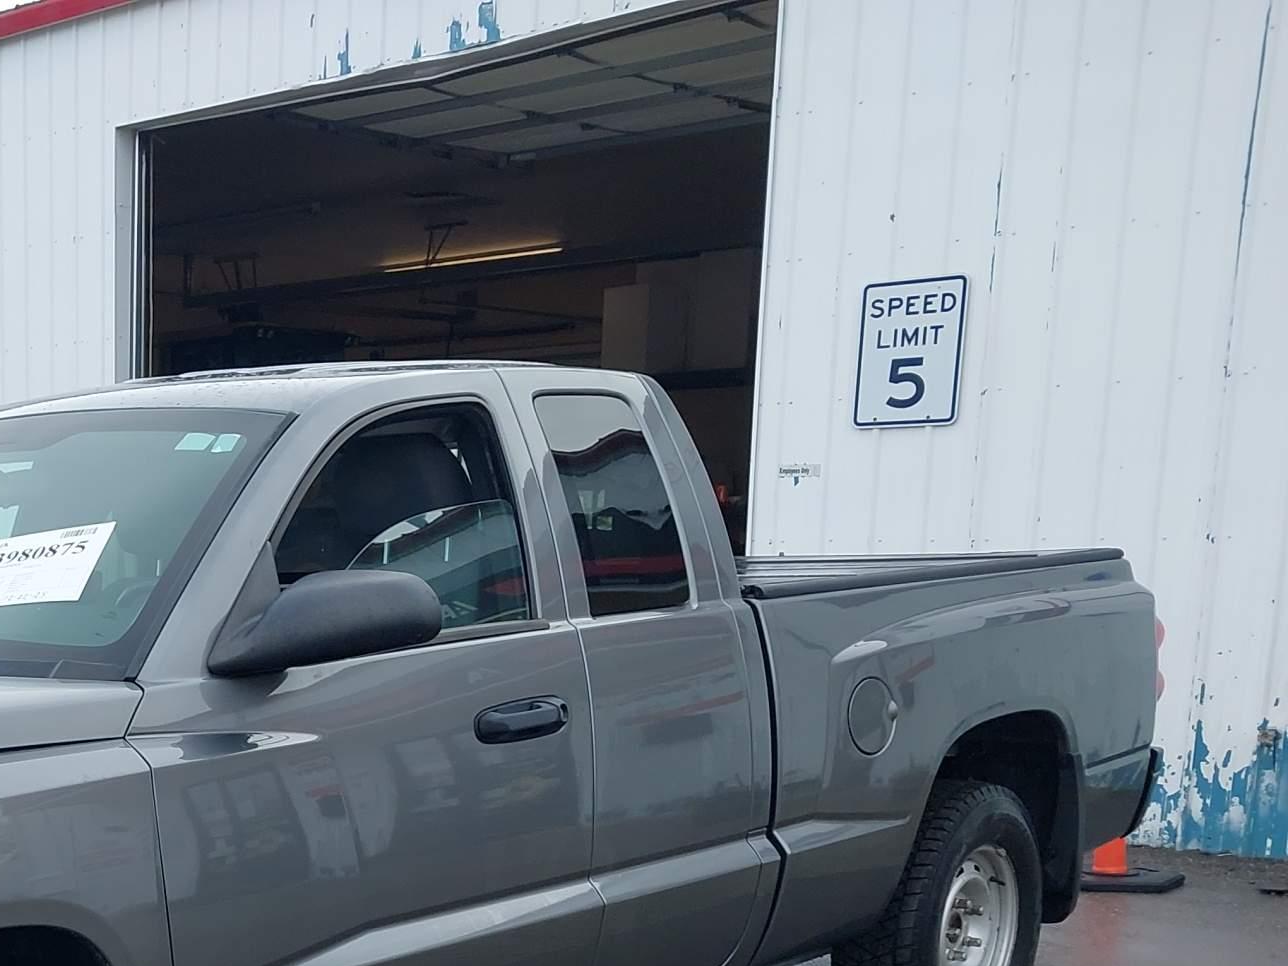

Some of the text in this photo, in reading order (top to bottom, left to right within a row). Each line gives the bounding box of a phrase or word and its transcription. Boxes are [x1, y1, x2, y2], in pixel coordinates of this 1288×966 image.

[870, 292, 958, 319] SPEED
[876, 325, 945, 349] LIMIT
[885, 356, 926, 409] 5
